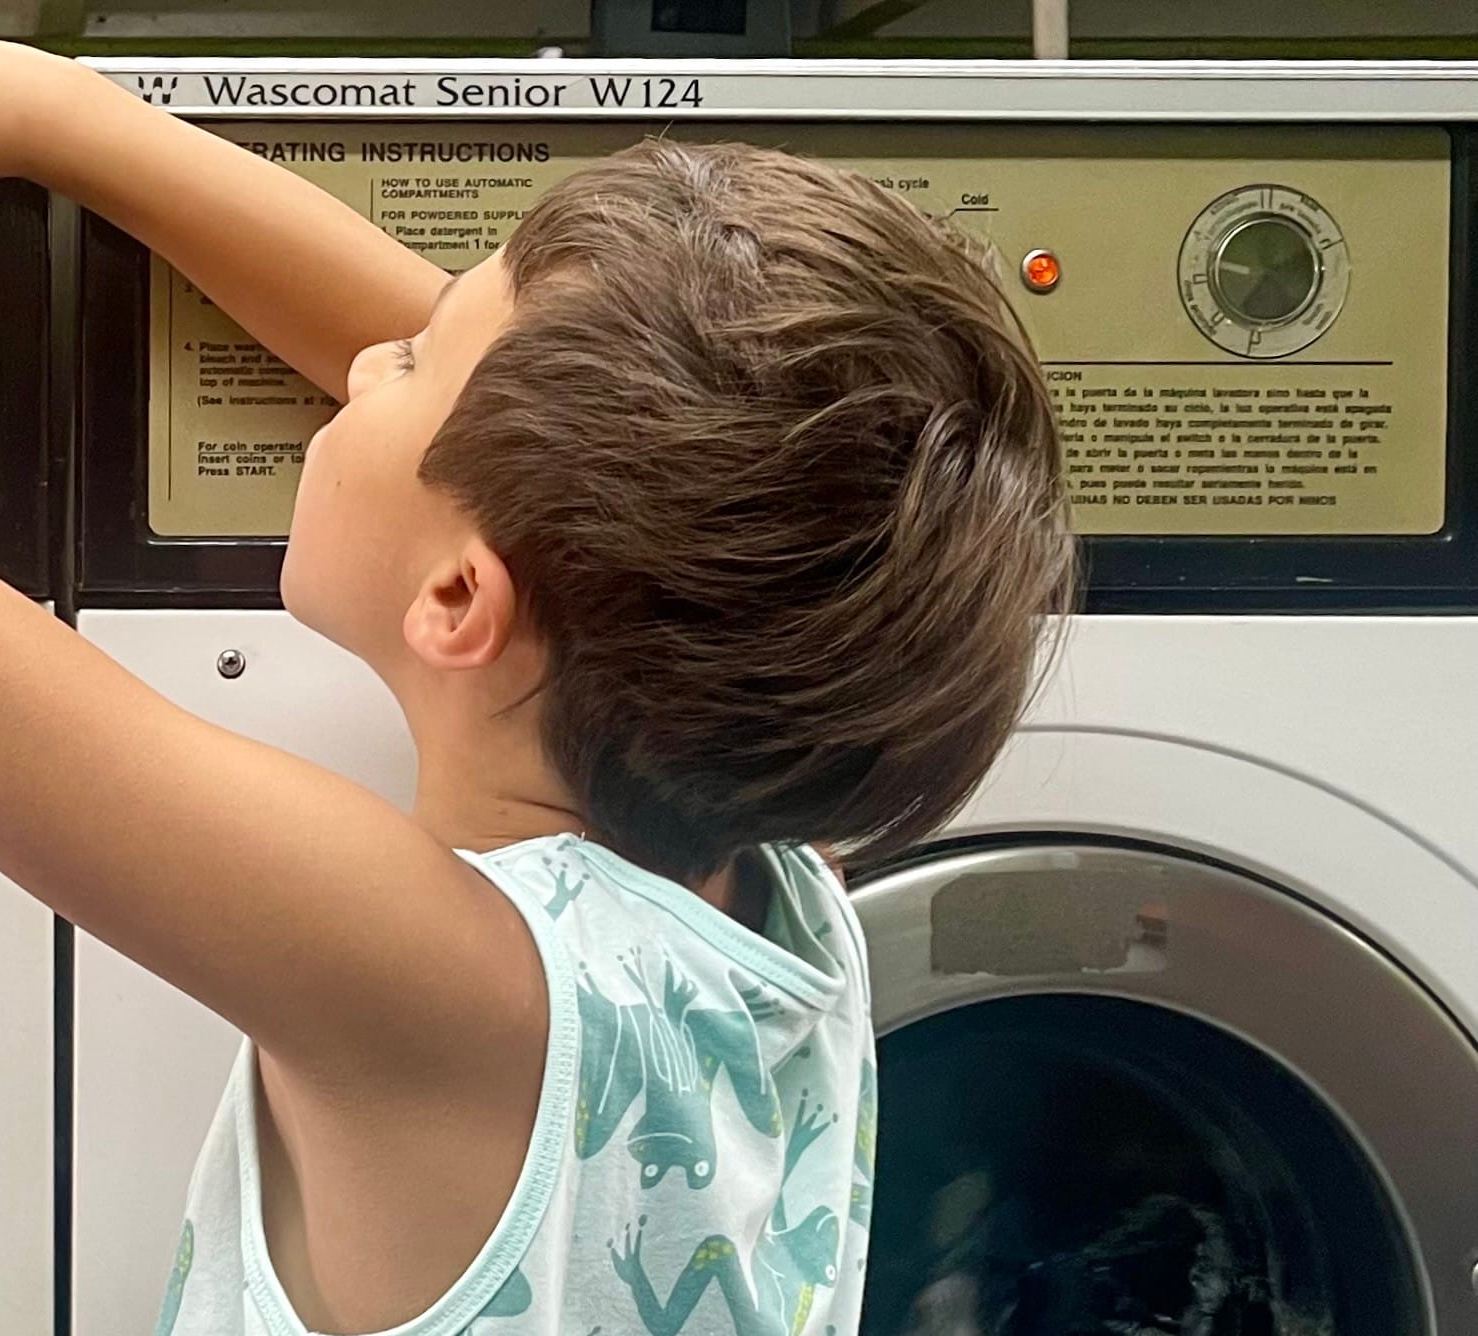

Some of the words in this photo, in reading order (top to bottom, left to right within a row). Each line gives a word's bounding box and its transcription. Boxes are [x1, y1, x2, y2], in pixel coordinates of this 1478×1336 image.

[203, 76, 416, 106] Wascomat
[436, 77, 566, 107] Senior
[235, 142, 345, 162] RATING
[359, 142, 550, 162] INSTRUCTIONS
[381, 178, 410, 187] HOW
[414, 178, 431, 187] TO
[435, 178, 459, 187] USE
[464, 178, 532, 187] AUTOMATIC
[381, 188, 479, 199] COMPARTMENTS
[961, 194, 989, 205] Cold
[381, 210, 405, 220] FOR
[410, 210, 478, 220] POWDERED
